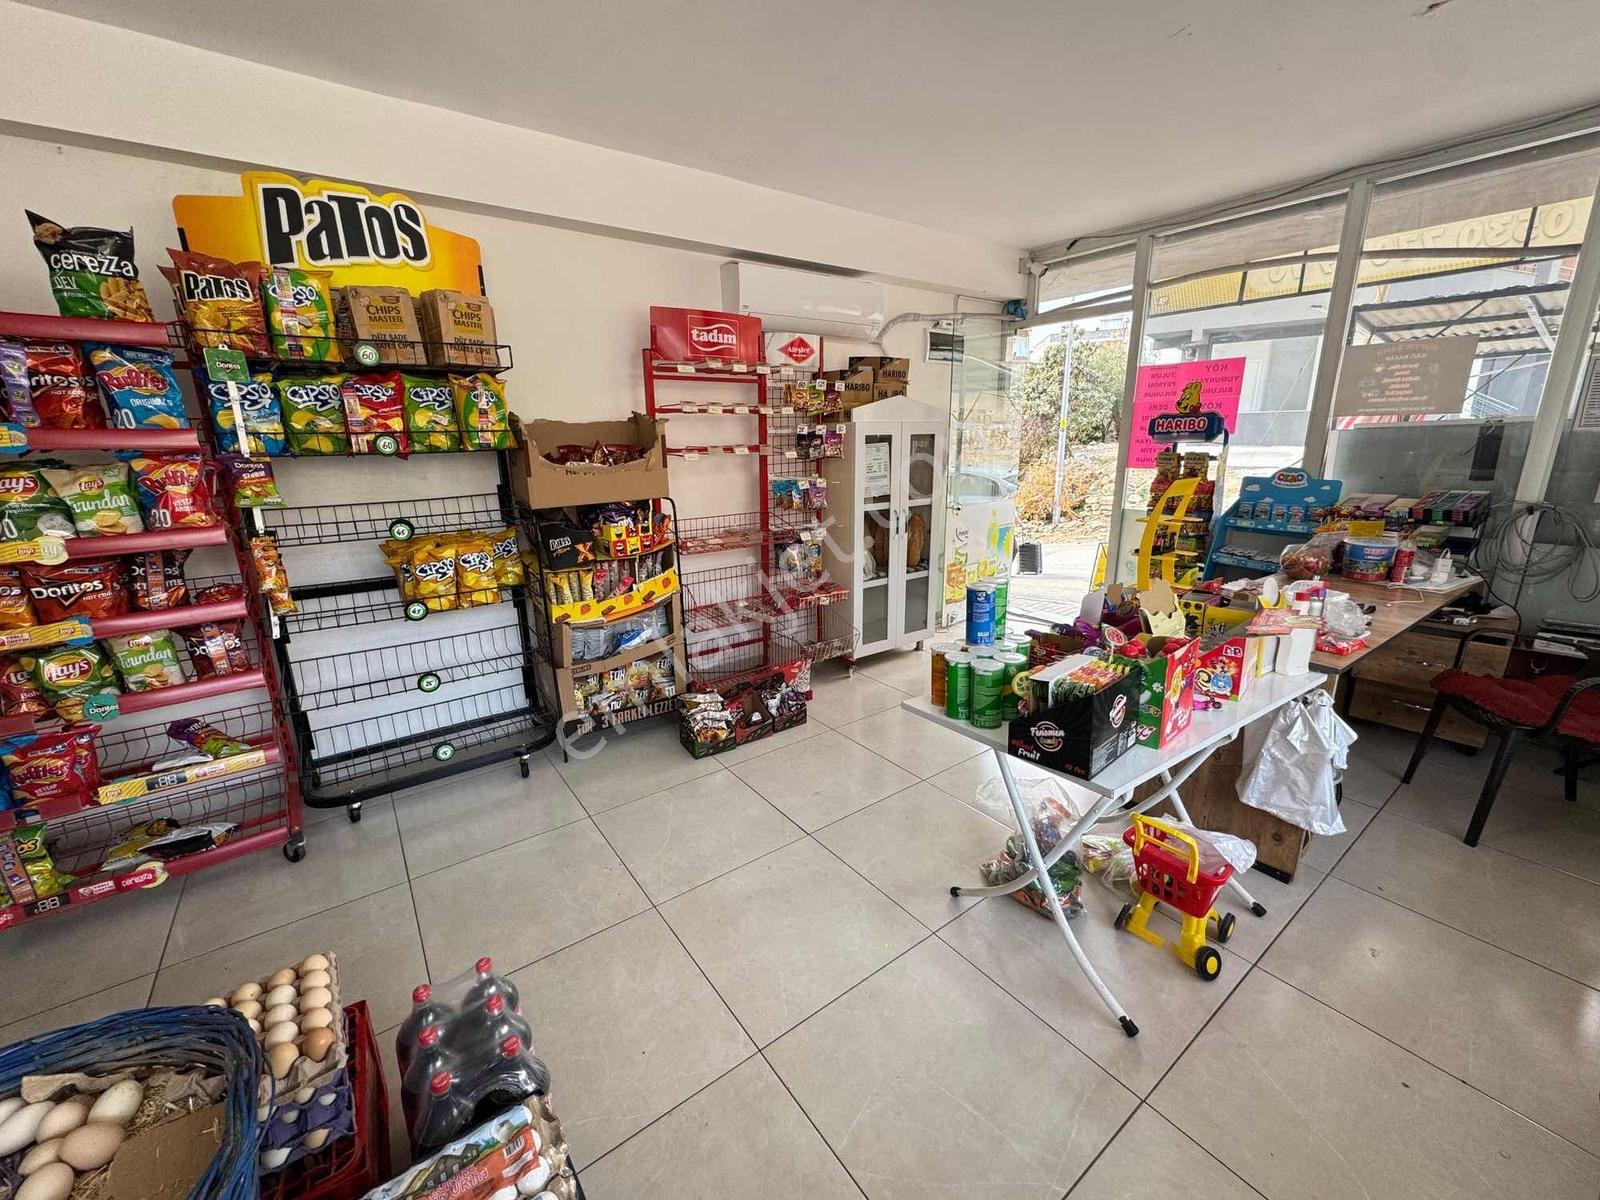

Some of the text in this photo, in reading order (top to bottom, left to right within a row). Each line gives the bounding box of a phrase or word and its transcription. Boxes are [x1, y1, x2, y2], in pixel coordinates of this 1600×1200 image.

[260, 185, 430, 267] PaTos
[181, 270, 254, 302] PaTos
[366, 304, 401, 315] CHIPS
[368, 315, 403, 324] MASTER
[452, 309, 482, 322] CHIPS
[453, 319, 483, 330] MASTER
[372, 332, 388, 341] DÜZ
[454, 336, 468, 345] DÜZ
[690, 328, 737, 344] tadım
[361, 350, 374, 361] 60
[215, 361, 241, 370] Doritos
[882, 369, 907, 379] HARIBO
[97, 369, 170, 395] Ruffles
[844, 383, 871, 392] HARIBO
[1155, 416, 1208, 433] HARIBO
[382, 440, 393, 449] 60
[233, 462, 265, 470] Doritos
[415, 557, 455, 577] CIPSO
[30, 582, 104, 601] Doritos
[602, 715, 609, 729] 3
[1017, 747, 1041, 760] Fruit
